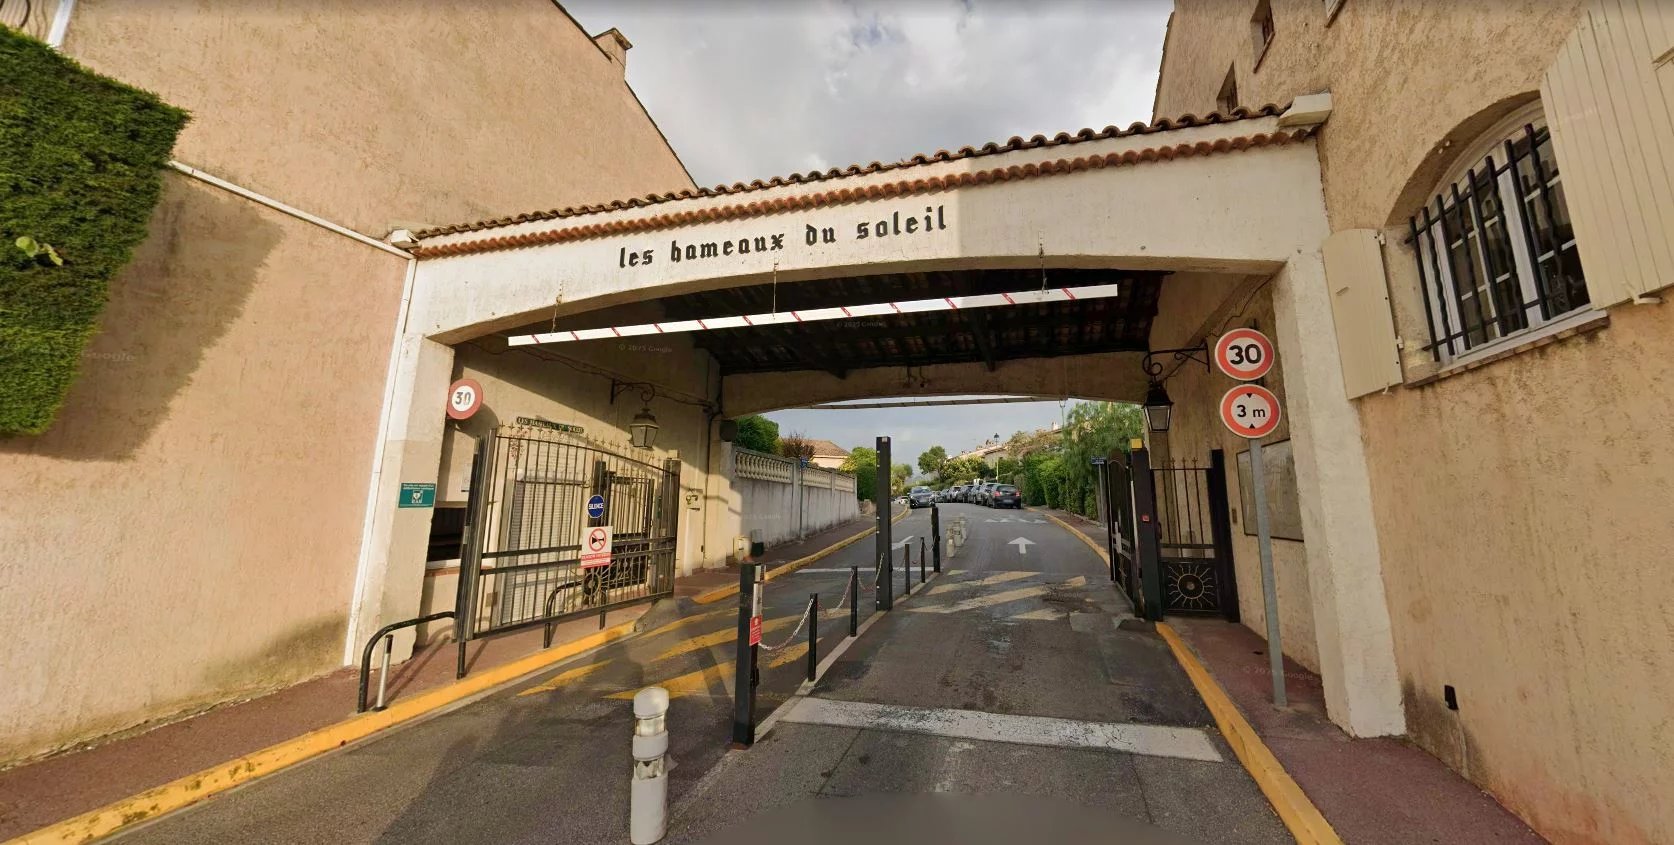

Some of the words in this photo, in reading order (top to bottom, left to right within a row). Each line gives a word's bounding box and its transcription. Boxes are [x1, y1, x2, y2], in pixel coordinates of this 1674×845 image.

[619, 247, 654, 269] les
[670, 233, 785, 263] hameaux
[805, 223, 837, 247] du
[856, 204, 948, 241] soleil
[1229, 343, 1262, 366] 30
[455, 391, 472, 405] 30
[1236, 404, 1247, 418] 3
[1253, 408, 1266, 418] m
